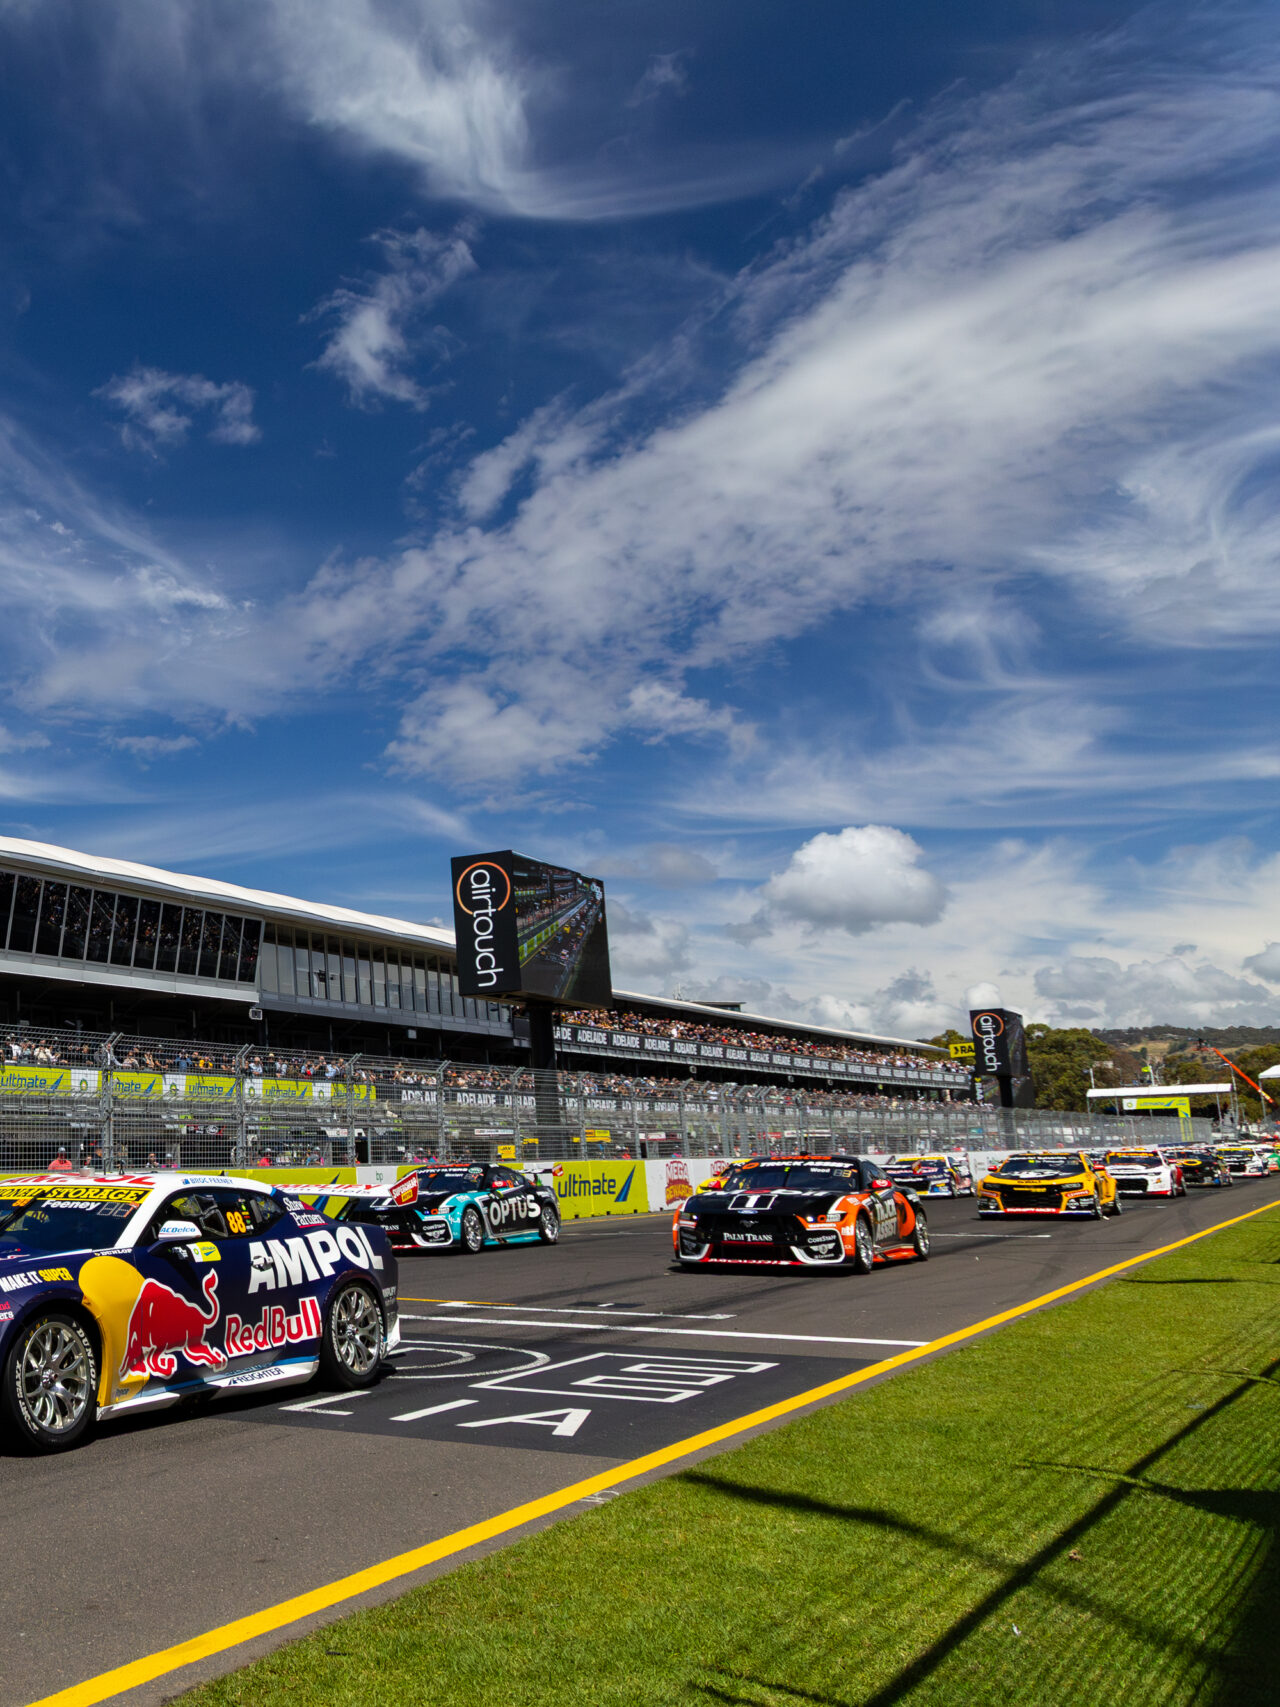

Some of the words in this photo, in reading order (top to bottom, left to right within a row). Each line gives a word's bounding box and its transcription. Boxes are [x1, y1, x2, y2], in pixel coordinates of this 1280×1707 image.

[470, 869, 504, 987] airtouch
[554, 1026, 571, 1041] LAIDE
[577, 1029, 607, 1045] ADELAIDE
[612, 1034, 640, 1049] ADELAIDE
[644, 1038, 670, 1052] ADELAIDE
[980, 1015, 1001, 1072] airtouch
[1, 1073, 47, 1089] ultimate
[375, 1170, 384, 1183] bp
[666, 1161, 687, 1177] MEGA
[711, 1161, 729, 1176] MEG
[46, 1186, 141, 1201] STORAGE
[392, 1177, 417, 1199] SUPERCHEAP
[557, 1172, 617, 1199] ultimate
[402, 1190, 413, 1201] AUTO
[41, 1199, 100, 1211] Feeney
[283, 1197, 306, 1212] Shaw
[489, 1194, 541, 1226] OPTUS
[226, 1211, 247, 1234] 88
[291, 1212, 325, 1227] Partners
[160, 1226, 196, 1234] ACDelco
[723, 1232, 743, 1242] PALM
[746, 1232, 773, 1242] TRANS
[875, 1218, 897, 1241] ASSIST
[99, 1248, 132, 1256] DUNLOP
[248, 1226, 385, 1294] AMPOL
[29, 1271, 43, 1285] IT
[37, 1267, 74, 1283] SUPER
[224, 1306, 269, 1358] Red
[271, 1296, 323, 1347] Bull
[76, 1328, 96, 1391] DUNLOP
[237, 1368, 284, 1384] FREIGHTER
